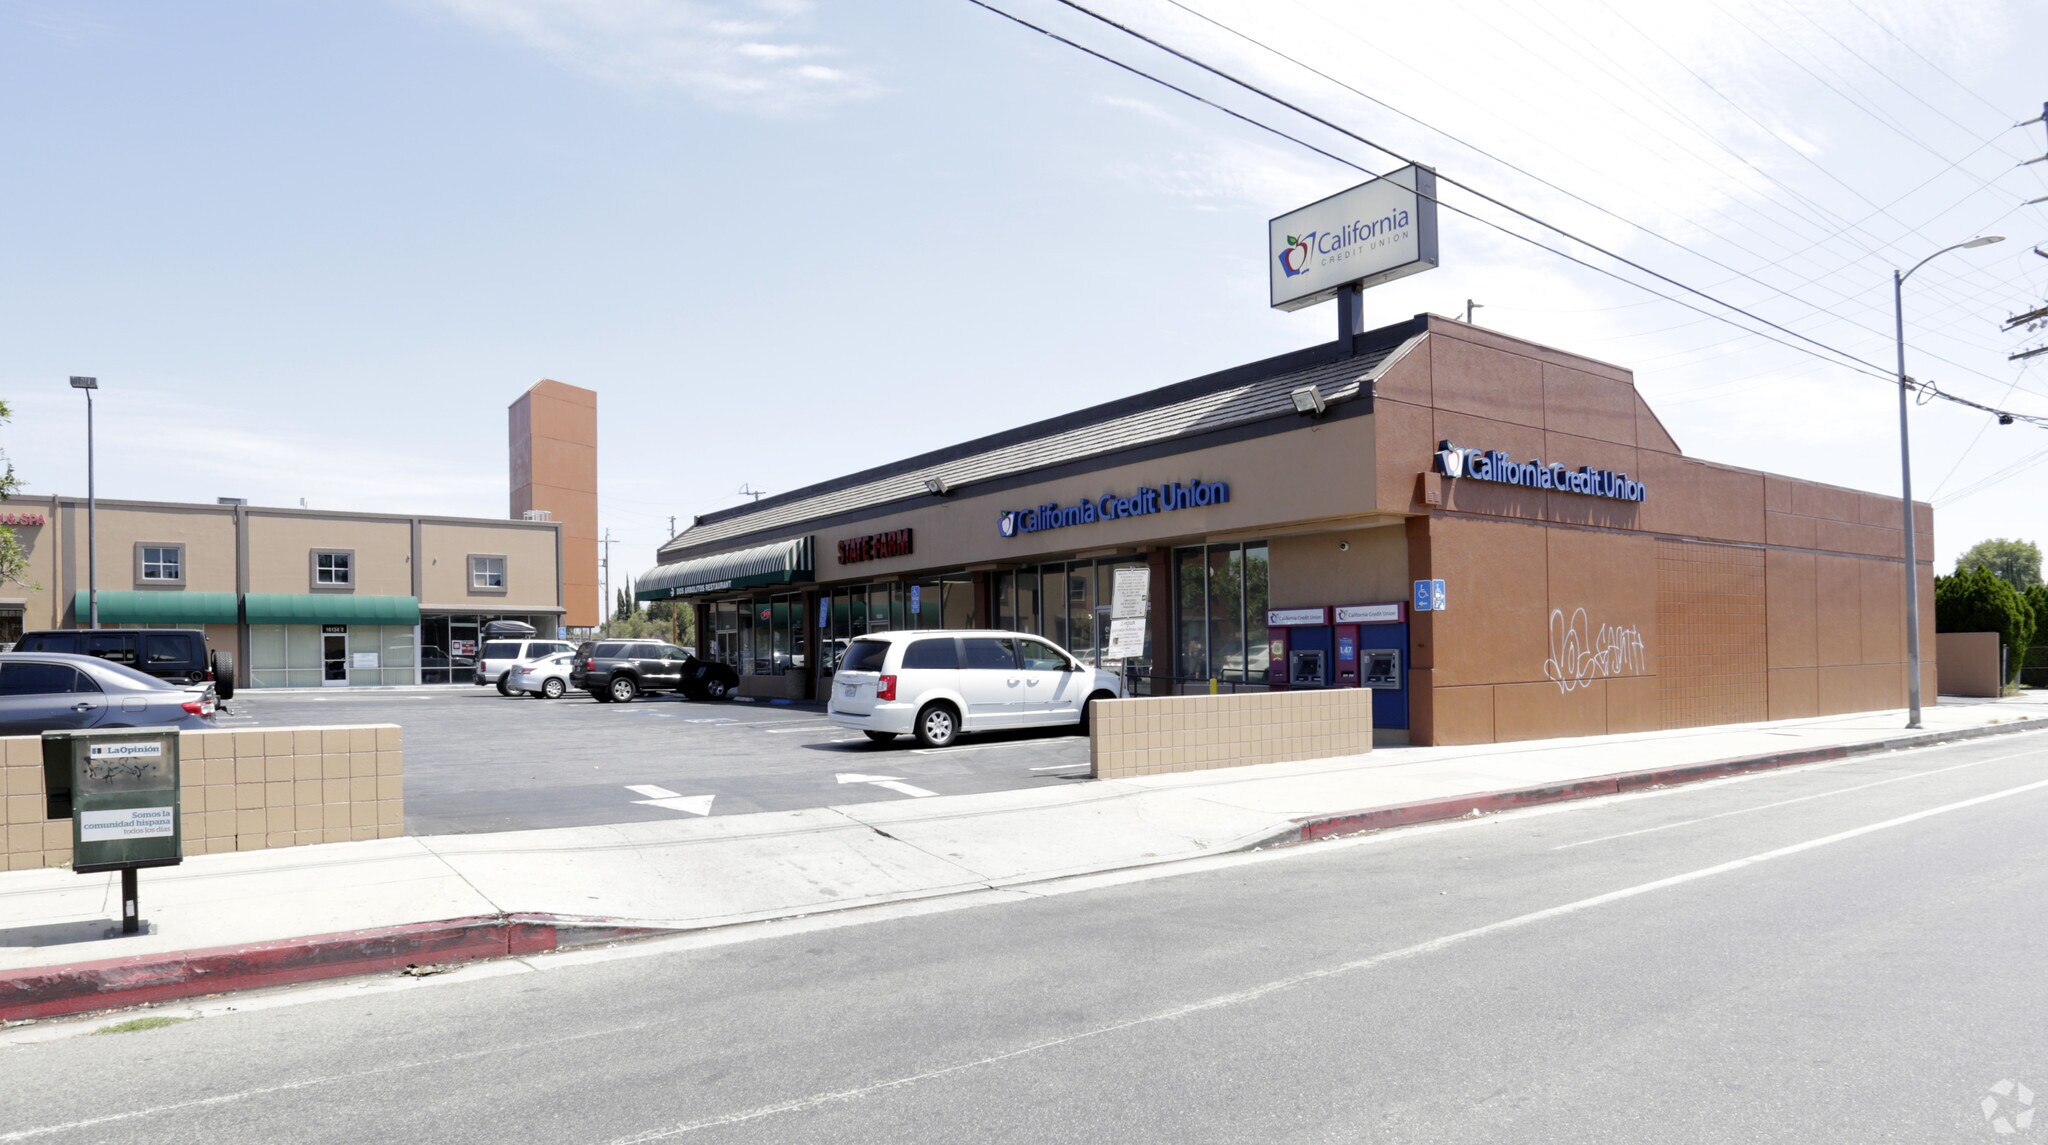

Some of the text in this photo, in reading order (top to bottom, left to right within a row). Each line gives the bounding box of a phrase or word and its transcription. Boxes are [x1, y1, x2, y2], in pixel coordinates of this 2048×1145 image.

[1318, 208, 1409, 254] California
[1321, 231, 1409, 266] CREDIT UNION
[1466, 448, 1646, 501] California Credit Union
[1017, 479, 1229, 533] California Credit Union
[20, 512, 45, 526] SPA
[838, 528, 913, 565] STATE FARM
[705, 580, 732, 592] RESTAURANT
[107, 746, 160, 755] LaOpinión
[83, 818, 171, 829] comunidad hispana
[132, 811, 161, 819] Somos
